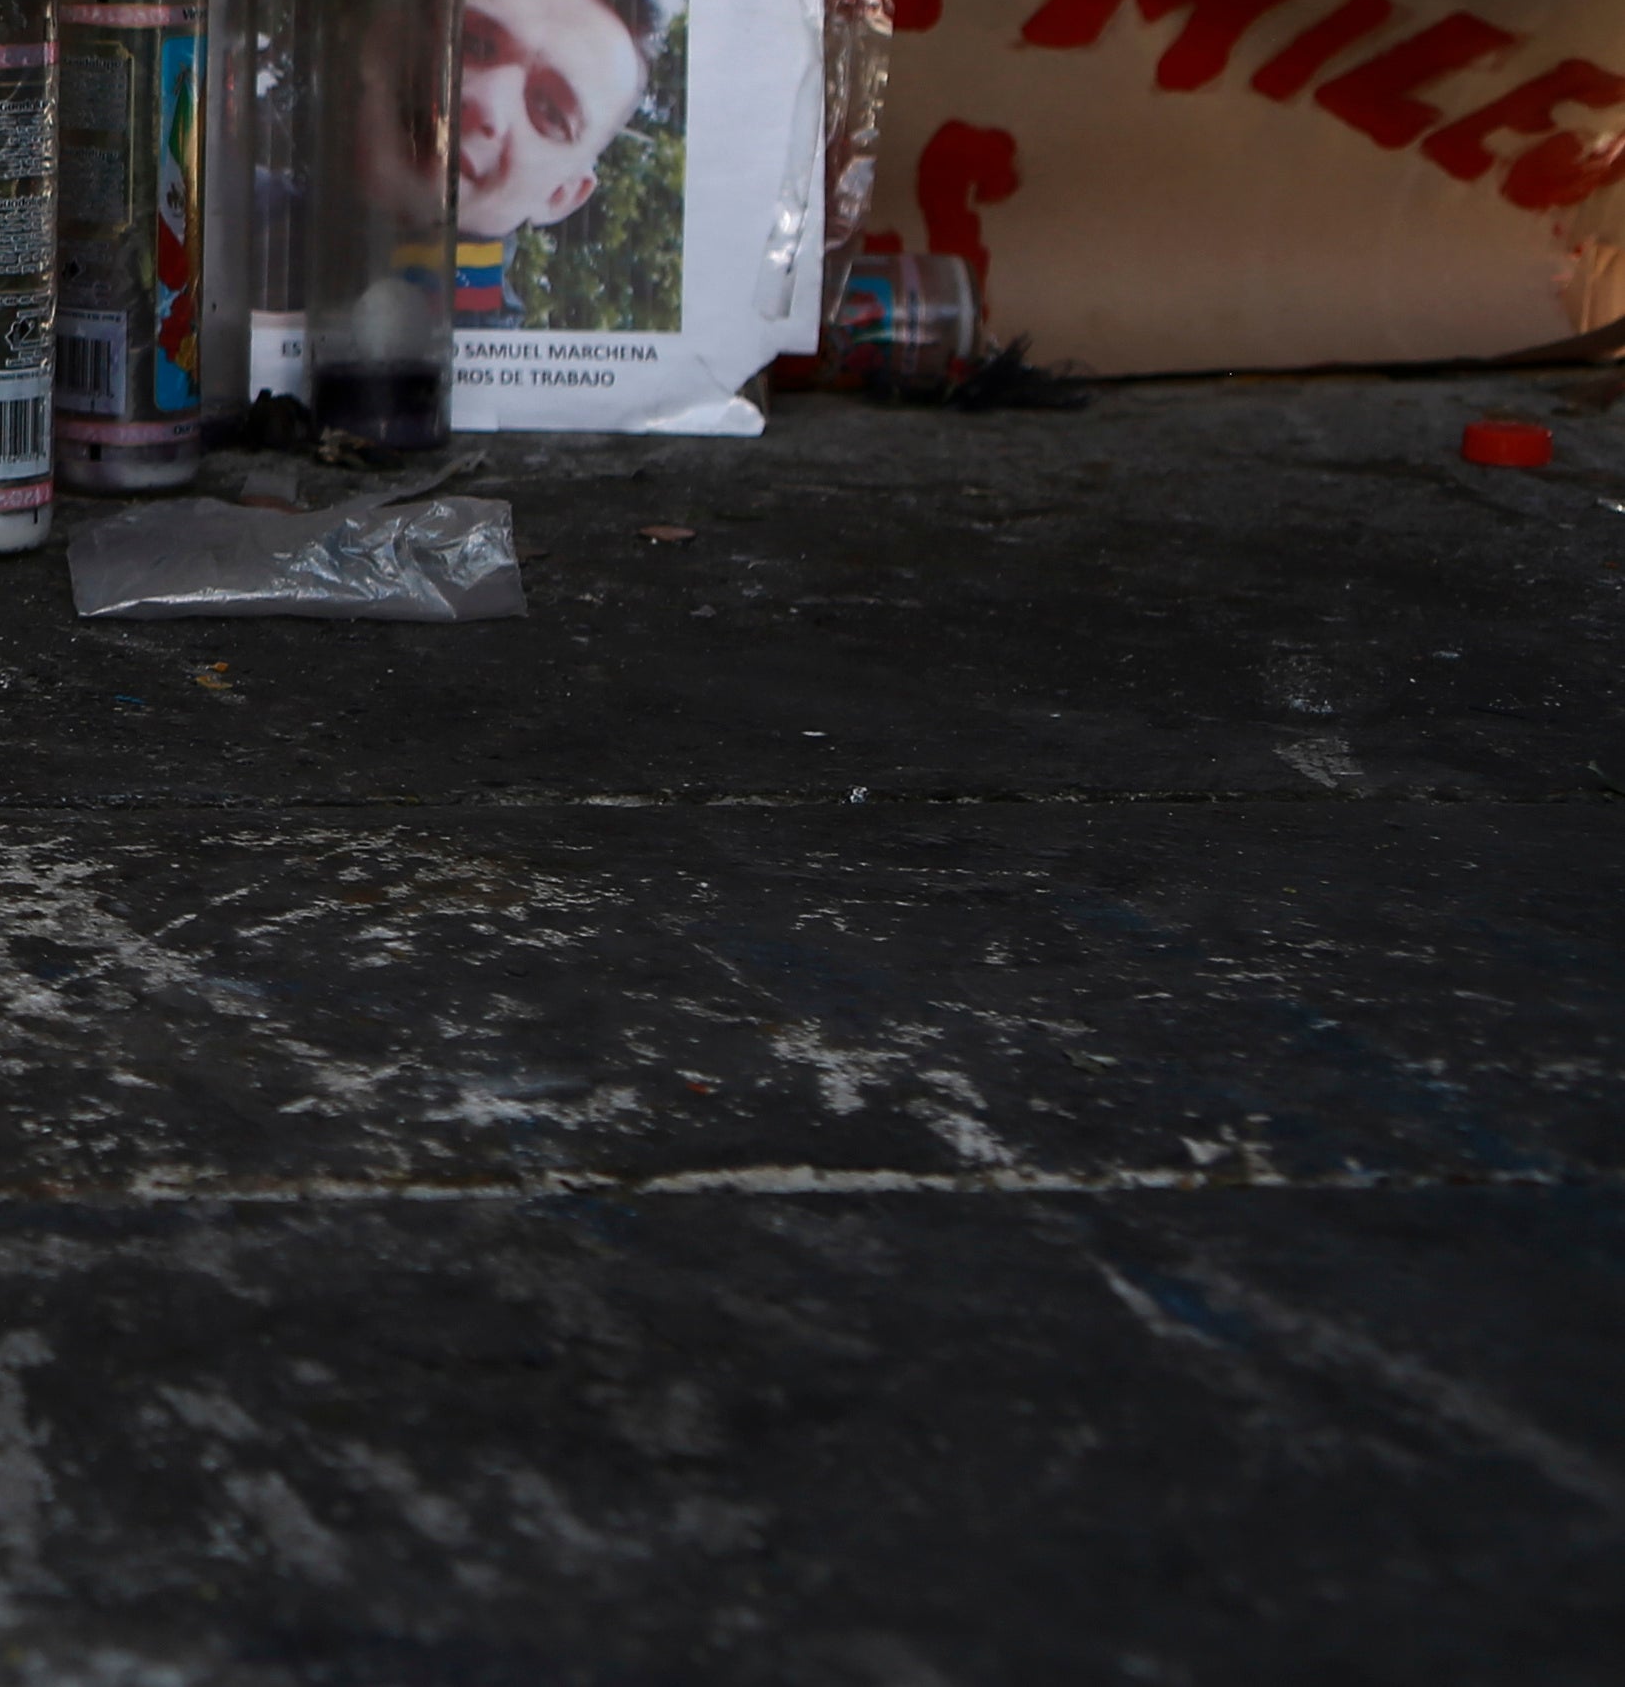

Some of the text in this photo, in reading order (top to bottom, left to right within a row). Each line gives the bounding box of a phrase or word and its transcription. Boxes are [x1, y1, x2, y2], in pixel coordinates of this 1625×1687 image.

[463, 342, 541, 361] SAMUEL
[549, 343, 659, 362] MARCHENA
[499, 369, 525, 386] DE
[529, 369, 617, 389] TRABAJO
